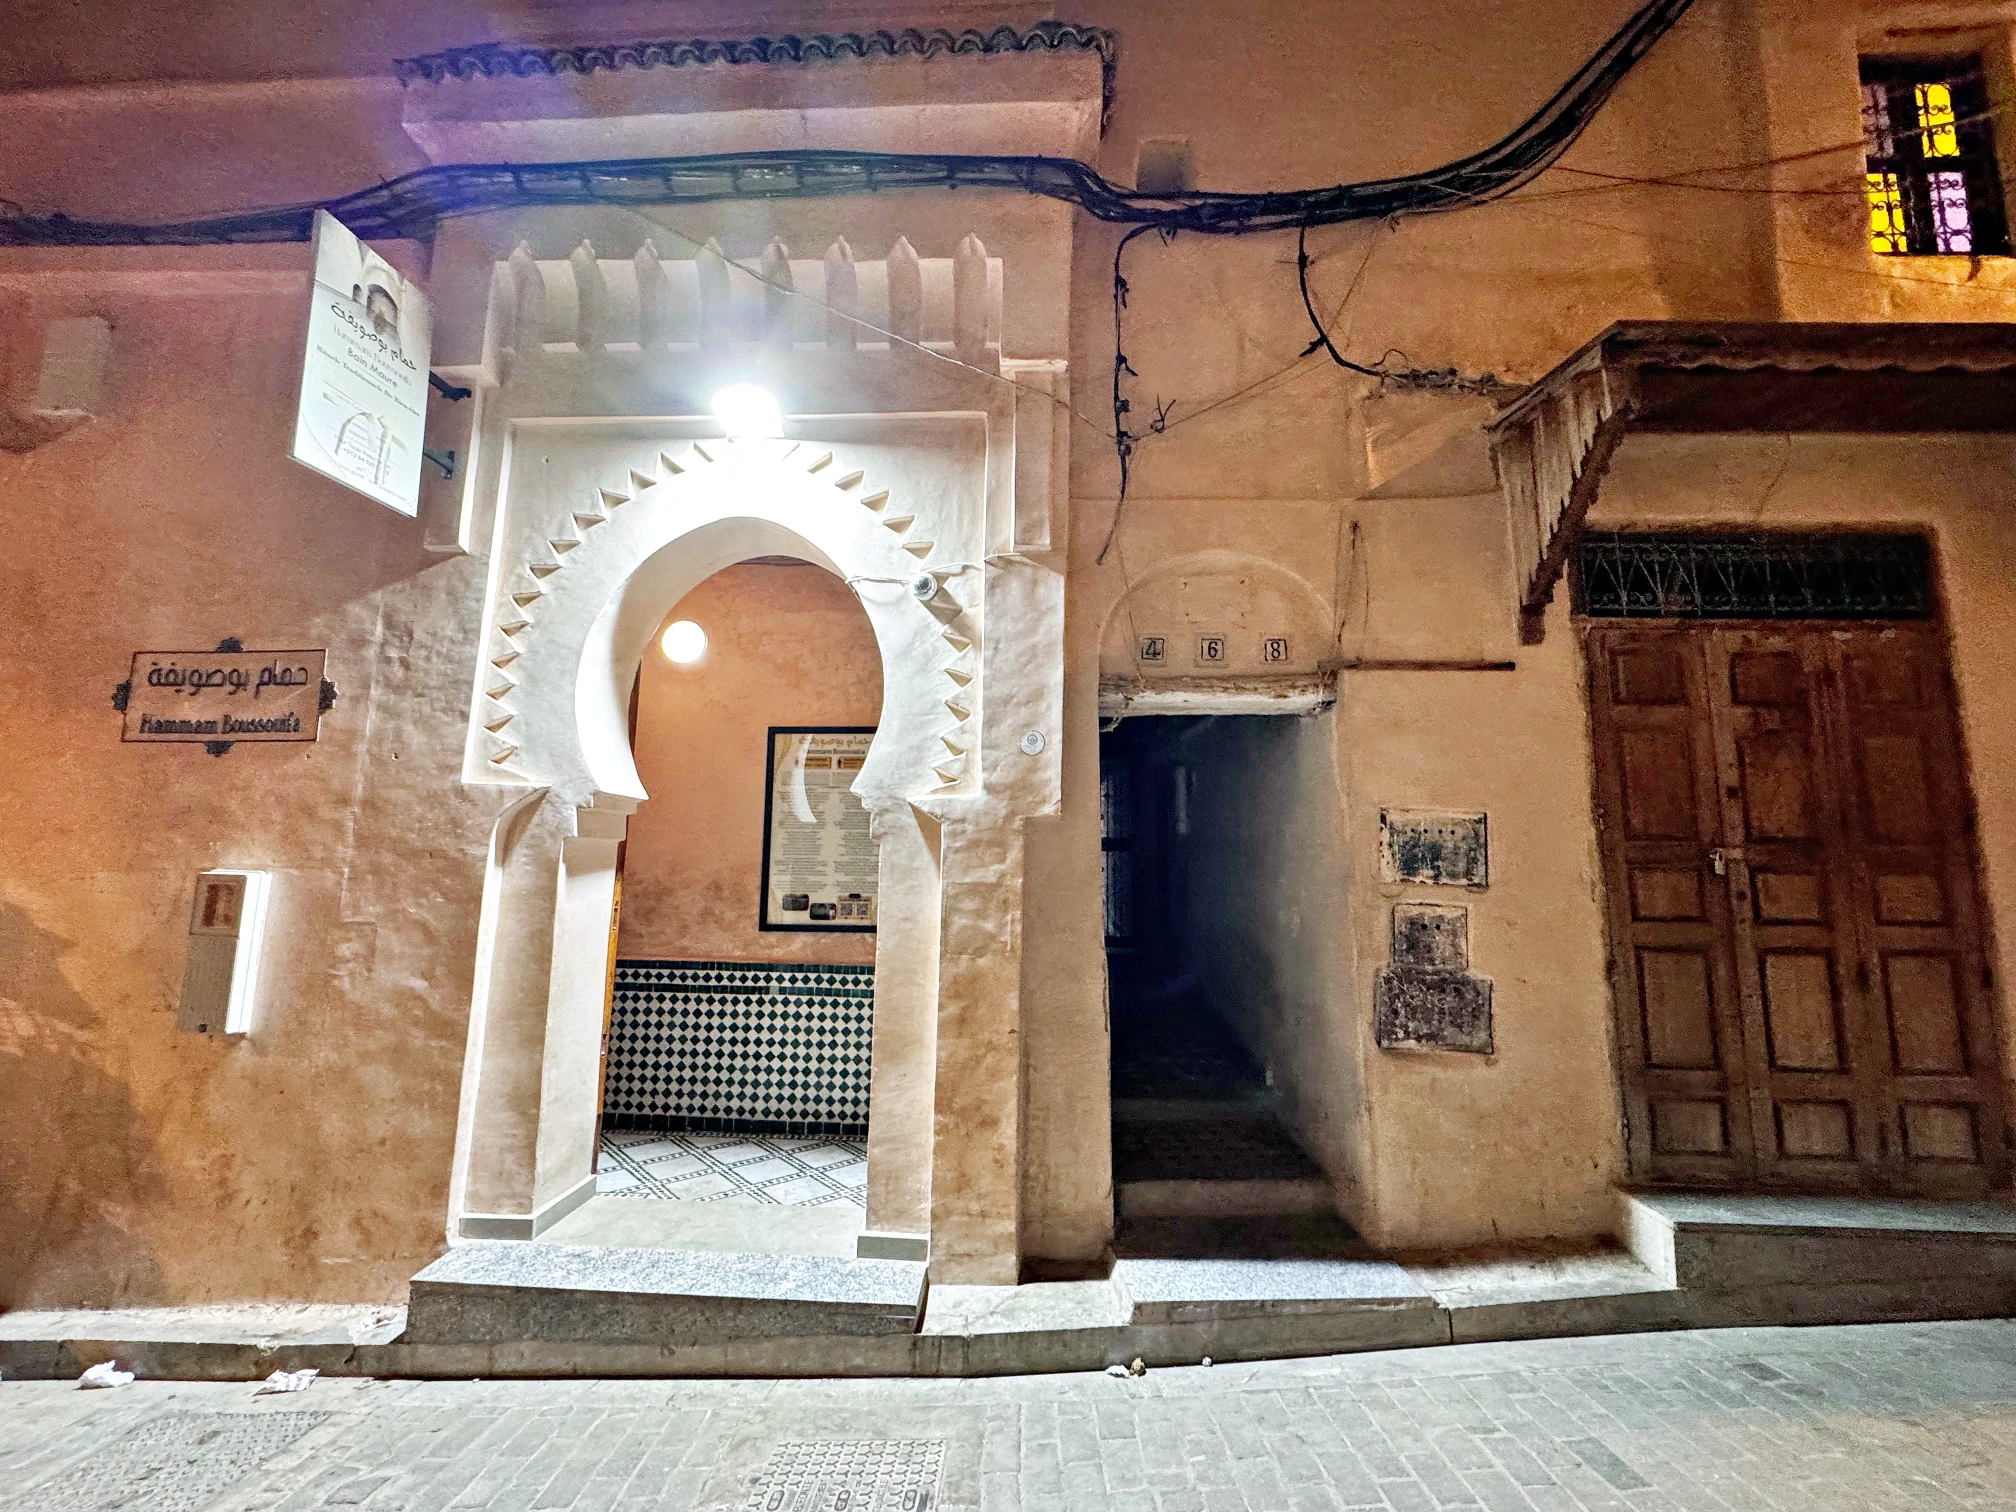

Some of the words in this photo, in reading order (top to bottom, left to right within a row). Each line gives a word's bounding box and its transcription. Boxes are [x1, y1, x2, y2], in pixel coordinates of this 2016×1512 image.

[347, 347, 368, 368] Bain
[370, 364, 398, 388] Maure
[1145, 640, 1161, 658] 4
[1207, 641, 1219, 658] 6
[1270, 641, 1282, 658] 8
[148, 661, 249, 697] بوصويفة
[254, 659, 309, 700] حمام
[140, 713, 218, 734] Hammam
